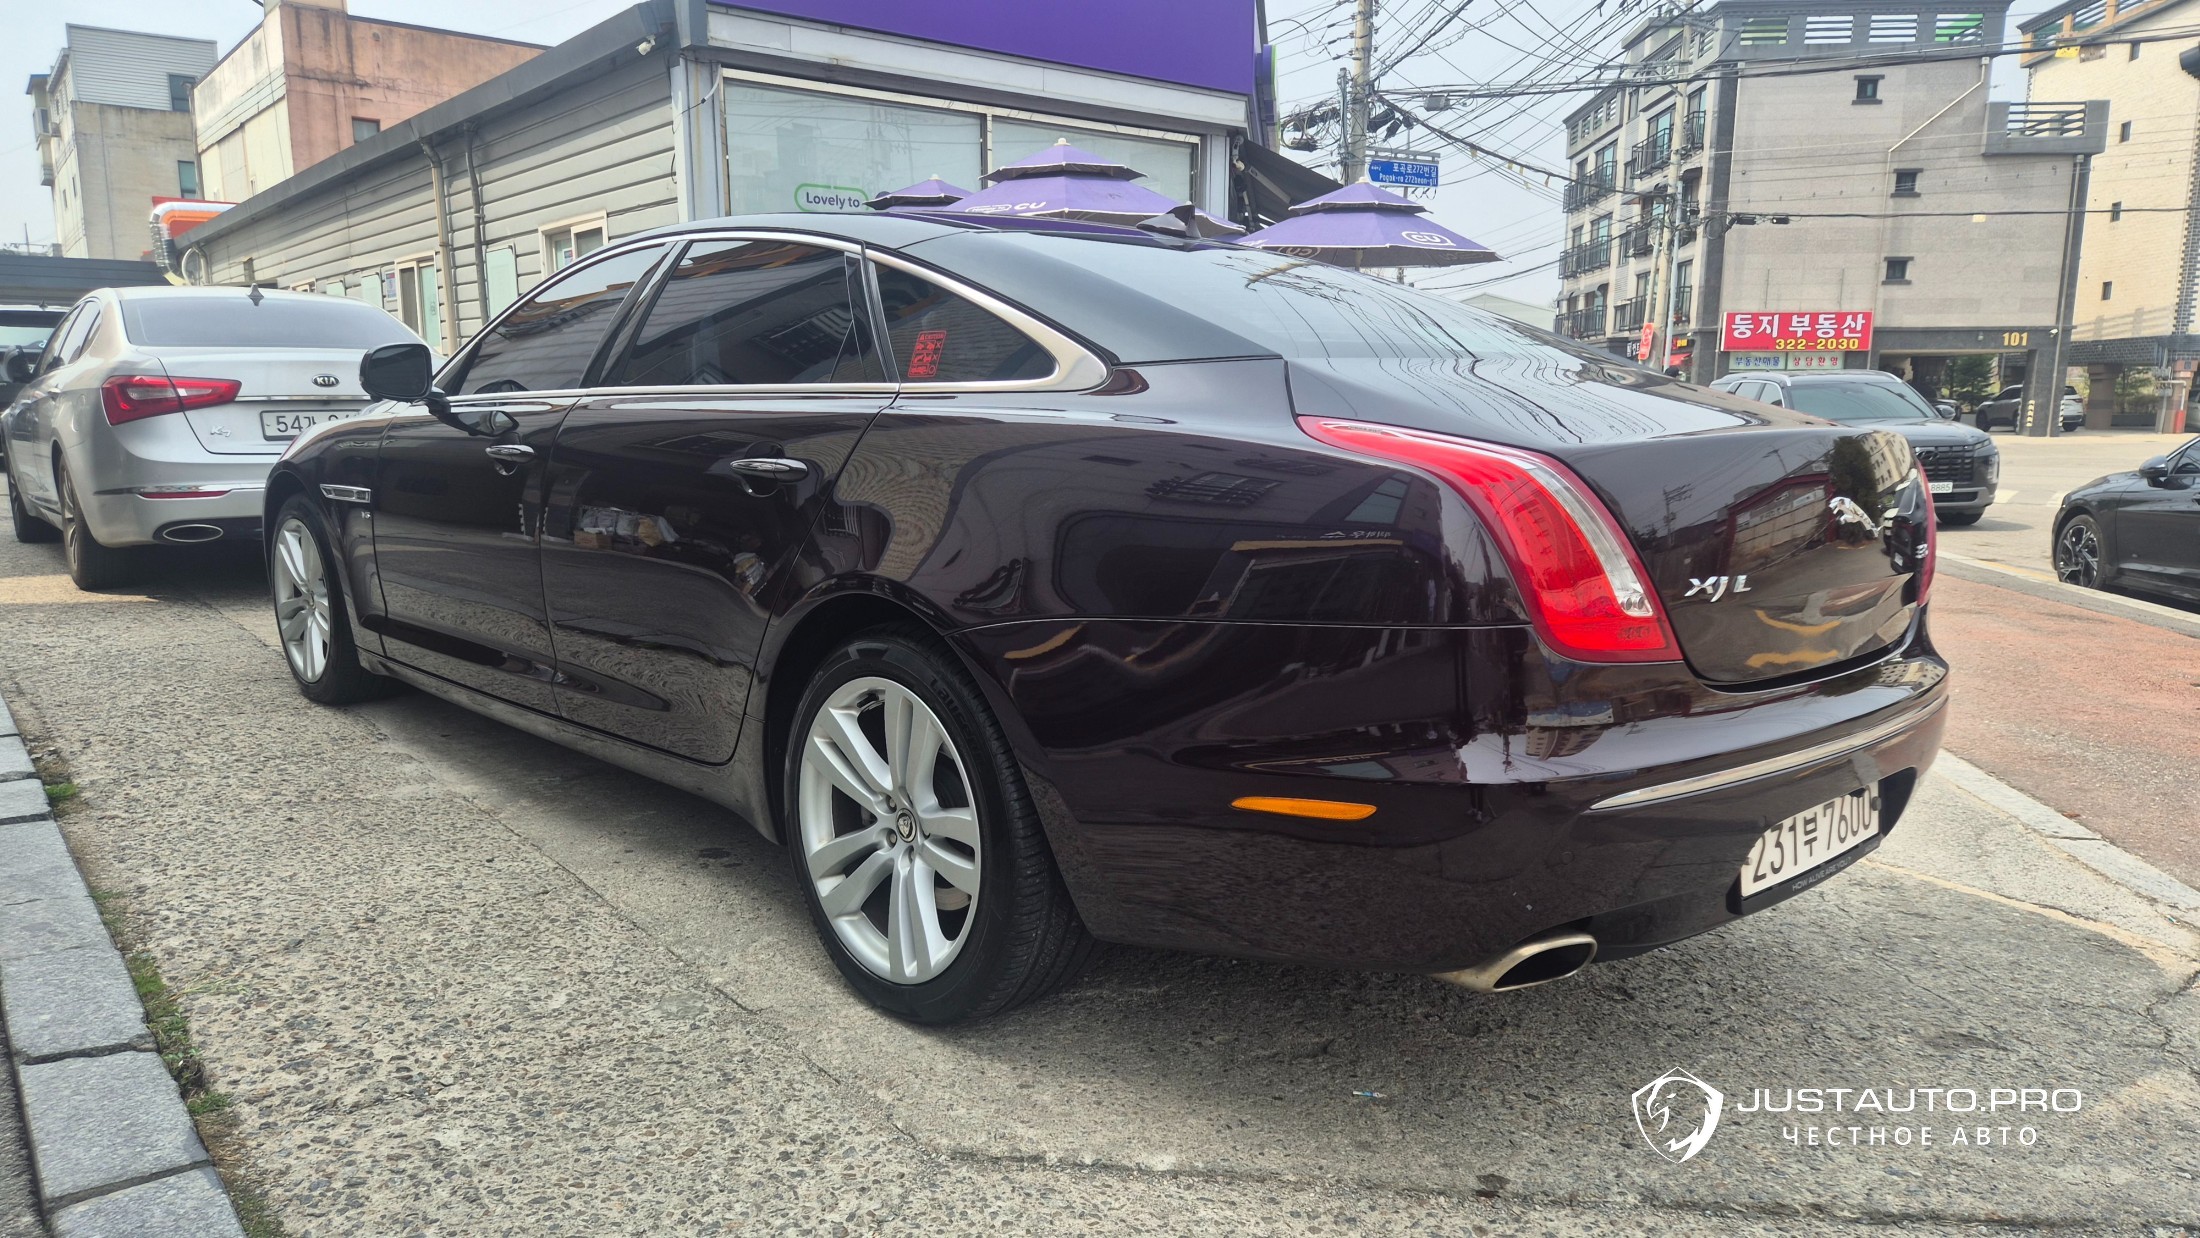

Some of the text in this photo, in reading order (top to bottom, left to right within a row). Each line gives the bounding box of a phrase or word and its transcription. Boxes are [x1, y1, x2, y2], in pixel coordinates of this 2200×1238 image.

[1393, 163, 1437, 177] 포곡로272번길
[806, 191, 860, 210] Lovely to
[1014, 201, 1047, 210] CU
[1411, 234, 1442, 243] CU
[1731, 313, 1866, 338] 둥지 부동산
[1775, 338, 1859, 350] 322-2030
[2002, 332, 2028, 346] 101
[317, 376, 337, 385] KIA
[1792, 878, 1808, 892] HOW
[1808, 869, 1826, 884] ALIVE
[1825, 864, 1837, 876] ARE
